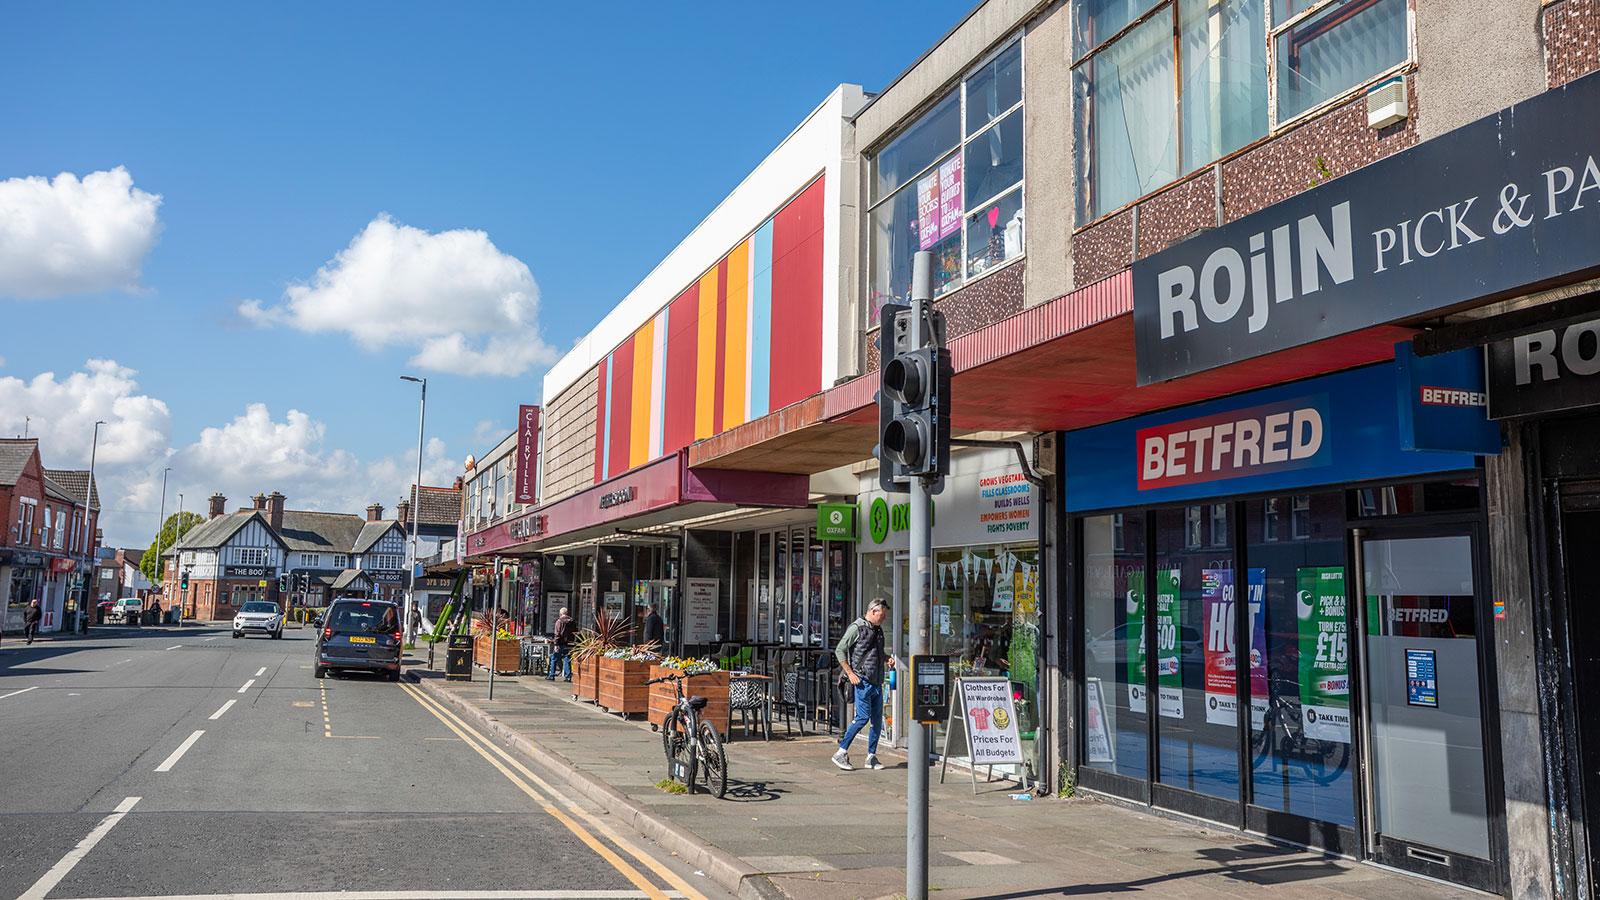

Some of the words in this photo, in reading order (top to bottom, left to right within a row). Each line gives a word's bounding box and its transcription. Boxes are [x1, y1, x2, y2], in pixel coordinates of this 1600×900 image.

[1158, 200, 1355, 340] ROjIN
[1371, 196, 1485, 274] PICK
[1491, 183, 1535, 236] &
[1422, 388, 1486, 407] BETFRED
[1142, 408, 1323, 480] BETFRED
[523, 412, 533, 494] CLAIRVILLE
[979, 476, 998, 487] GROWS
[999, 473, 1025, 484] VEGETABL
[982, 488, 994, 498] FILLS
[995, 484, 1030, 496] CLASSROOMS
[994, 498, 1012, 508] BUILDS
[1013, 496, 1030, 506] WELLS
[980, 511, 1008, 522] EMPOWERS
[1008, 509, 1030, 520] WOMEN
[826, 527, 846, 535] OXFAM
[987, 523, 1005, 533] FIGHTS
[1005, 521, 1030, 532] POVERTY
[1253, 584, 1264, 602] IN
[1319, 595, 1333, 606] PICK
[1333, 595, 1340, 605] &
[1325, 606, 1345, 617] BONUS
[1387, 608, 1448, 623] BETFRED
[1318, 622, 1333, 632] TURN
[965, 684, 992, 692] Clothes
[1327, 679, 1346, 690] BONUS
[1318, 713, 1333, 721] TAKE
[1334, 714, 1349, 722] TIME
[973, 735, 999, 743] Prices
[1000, 735, 1013, 743] For
[985, 749, 1015, 758] Budgets
